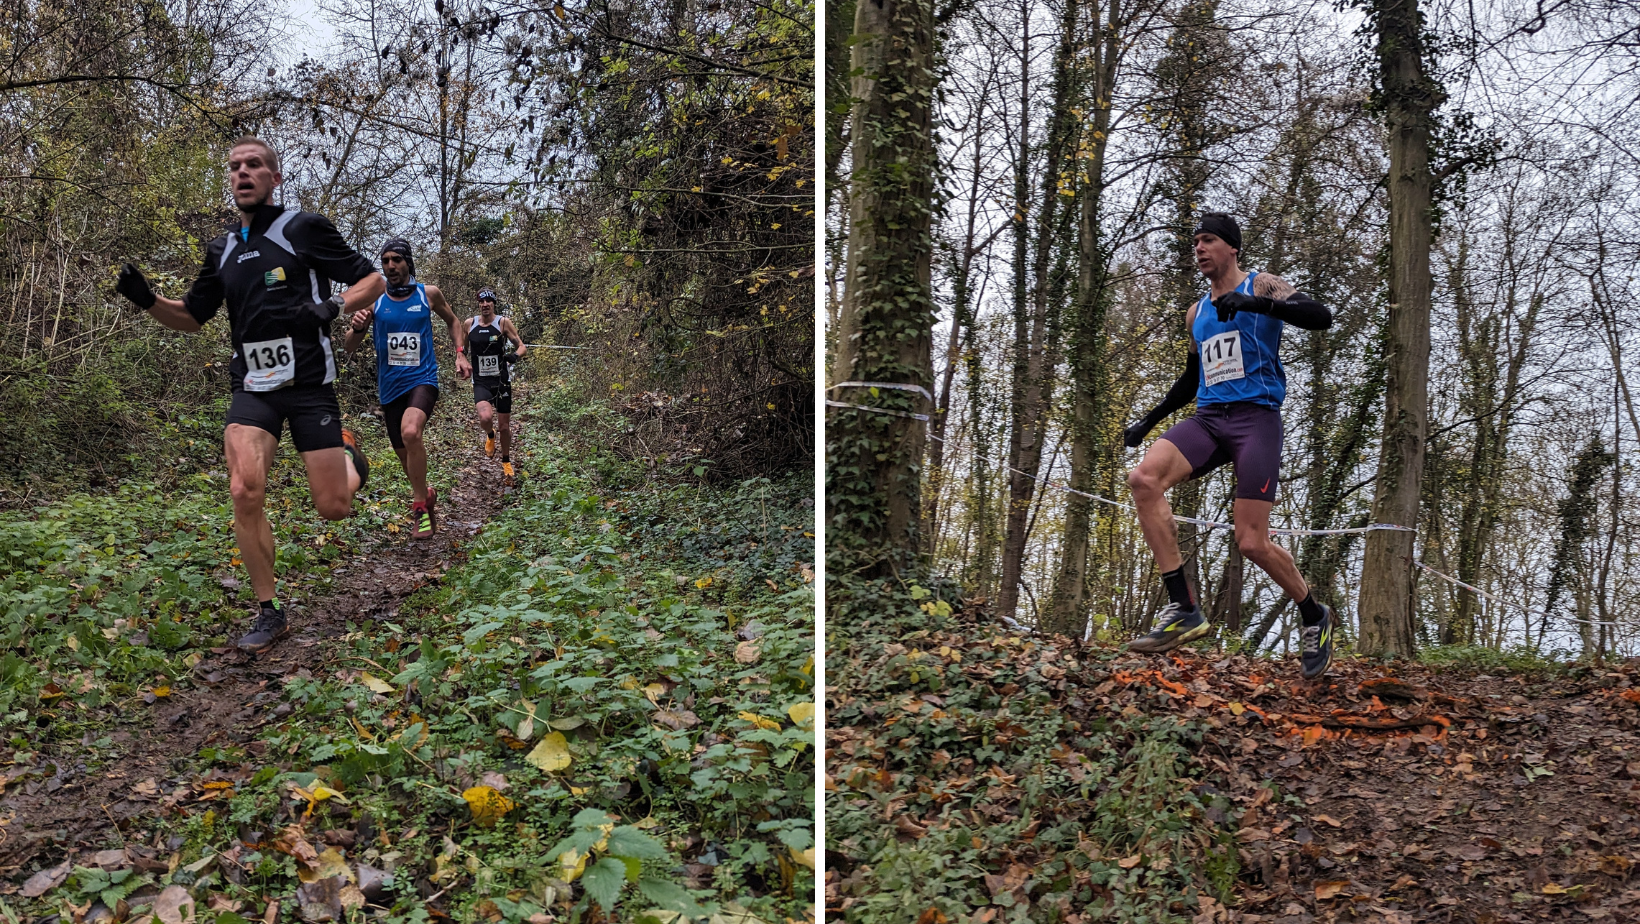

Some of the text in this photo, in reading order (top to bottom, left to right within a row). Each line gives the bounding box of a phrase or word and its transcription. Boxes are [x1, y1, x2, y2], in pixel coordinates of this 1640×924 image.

[390, 336, 417, 351] 043
[1205, 337, 1236, 363] 117
[249, 345, 290, 370] 136
[480, 357, 496, 367] 139
